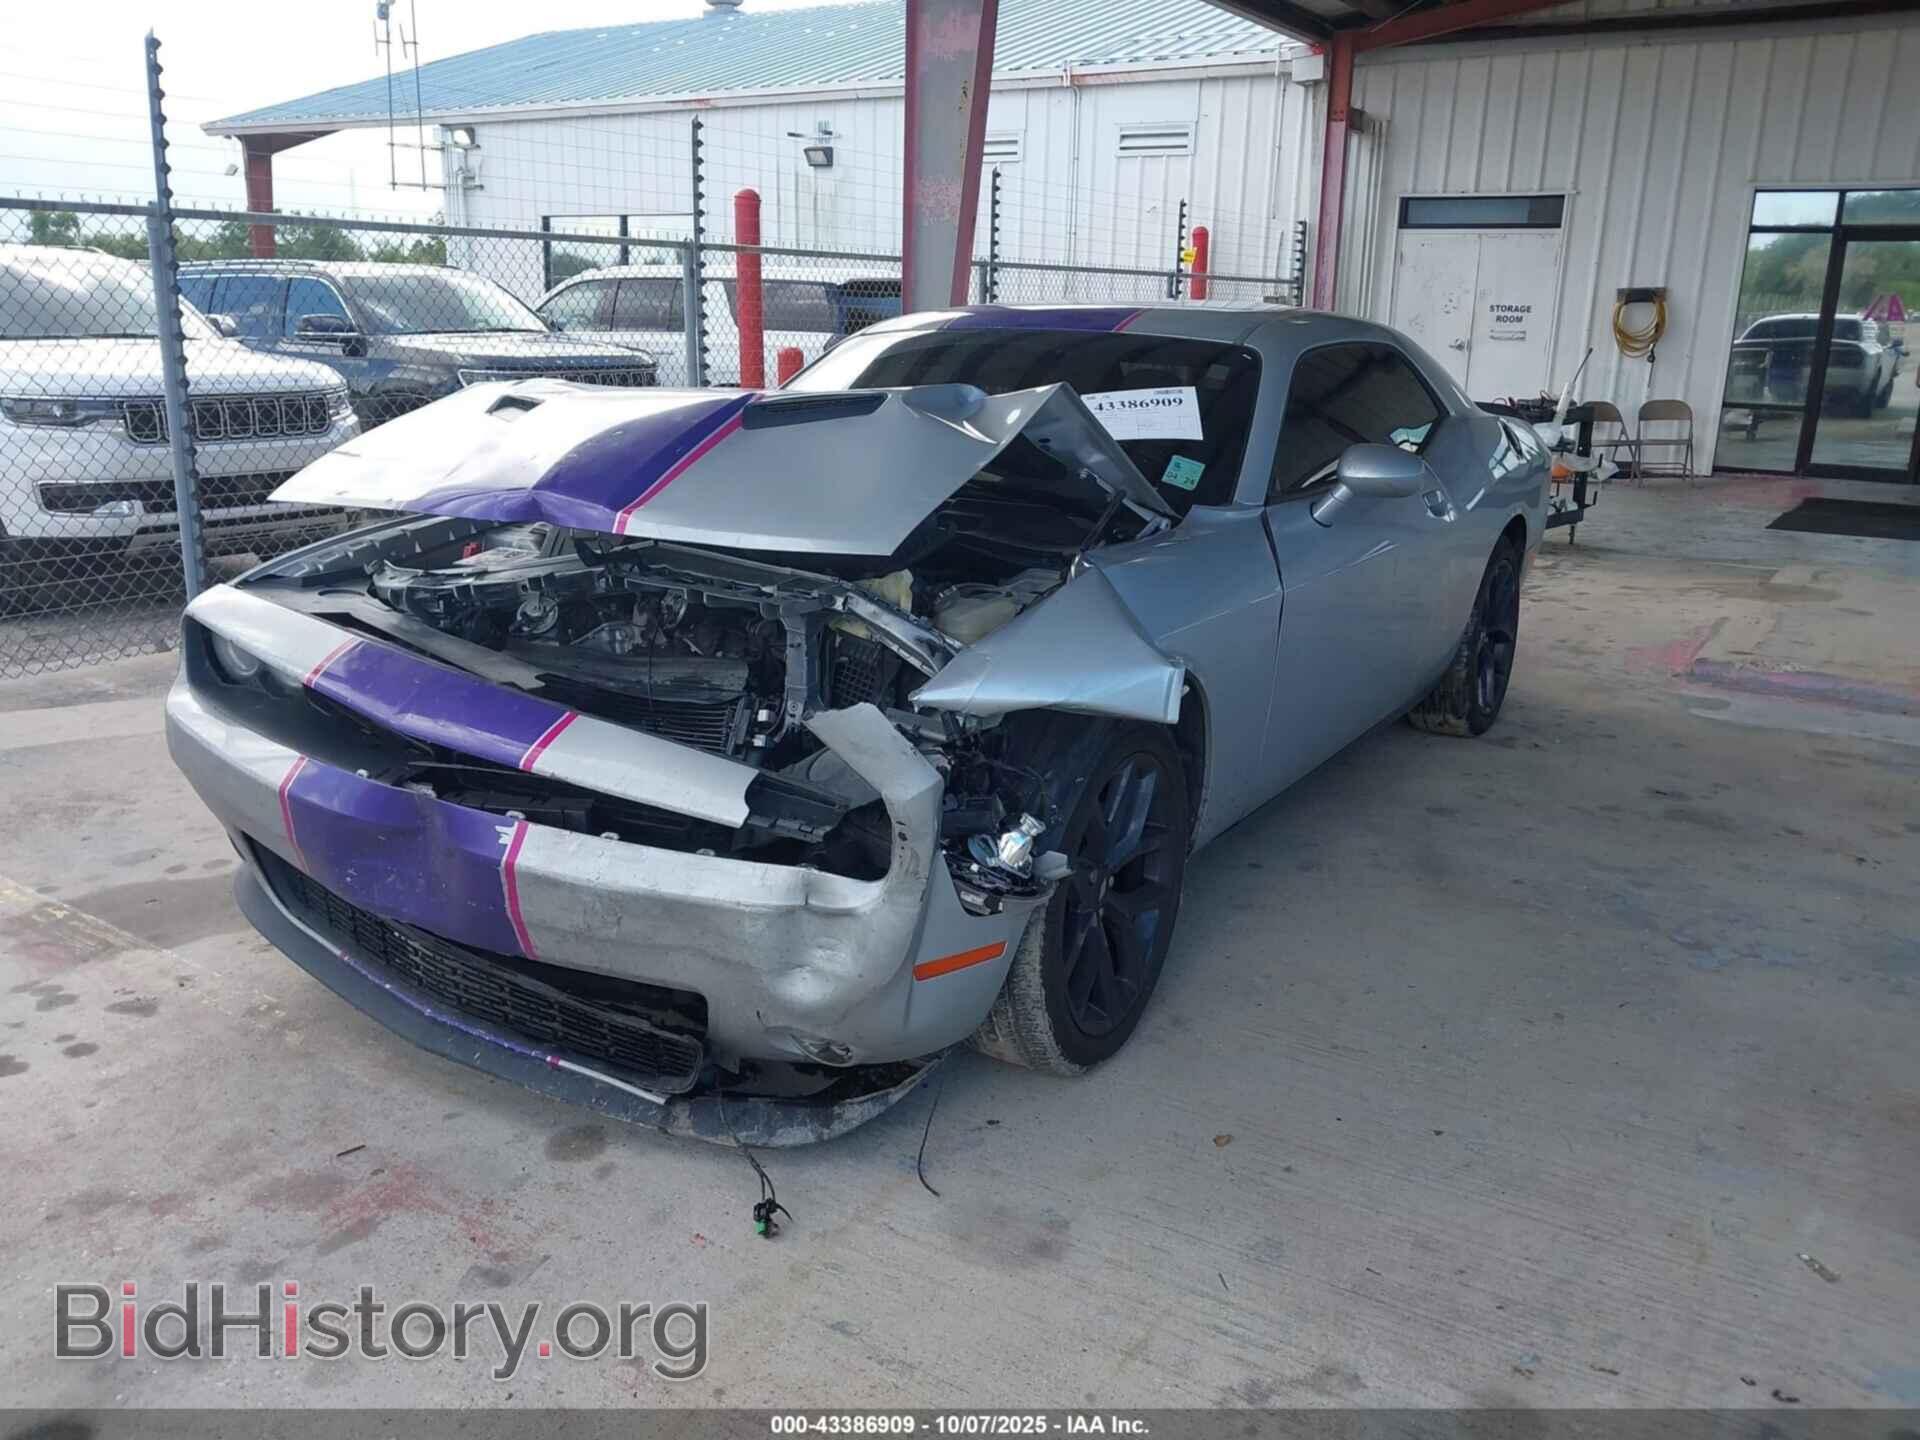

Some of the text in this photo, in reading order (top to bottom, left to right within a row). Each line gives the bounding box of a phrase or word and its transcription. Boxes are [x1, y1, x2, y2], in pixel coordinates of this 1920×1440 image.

[1489, 304, 1532, 313] STORAGE
[1495, 314, 1524, 323] ROOM
[1095, 397, 1183, 411] 43386909
